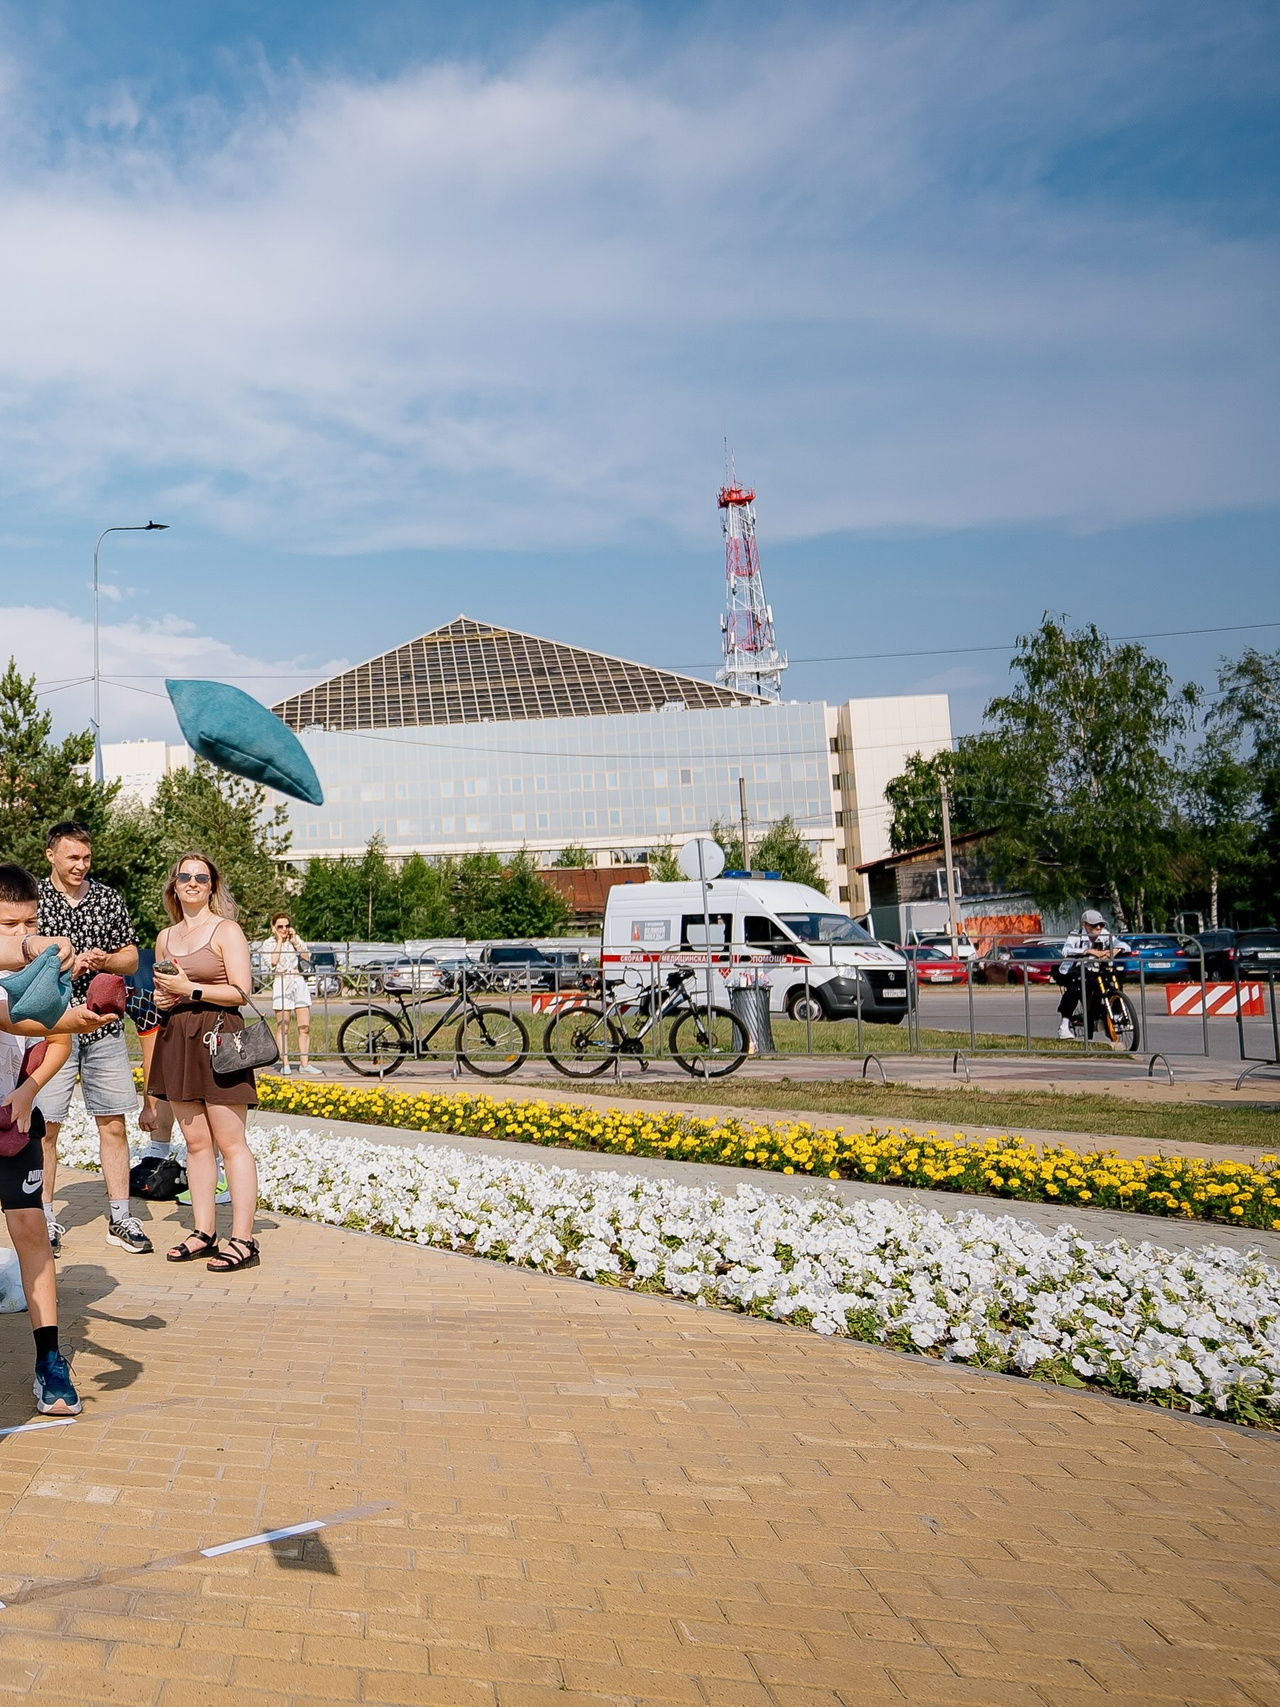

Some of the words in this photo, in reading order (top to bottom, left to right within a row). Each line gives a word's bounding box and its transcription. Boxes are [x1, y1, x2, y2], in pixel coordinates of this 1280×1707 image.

[620, 955, 644, 963] СКОРАЯ
[661, 954, 709, 963] МЕДИЦИНСКАЯ
[751, 954, 787, 963] ПОМОЩЬ
[853, 951, 894, 962] 103
